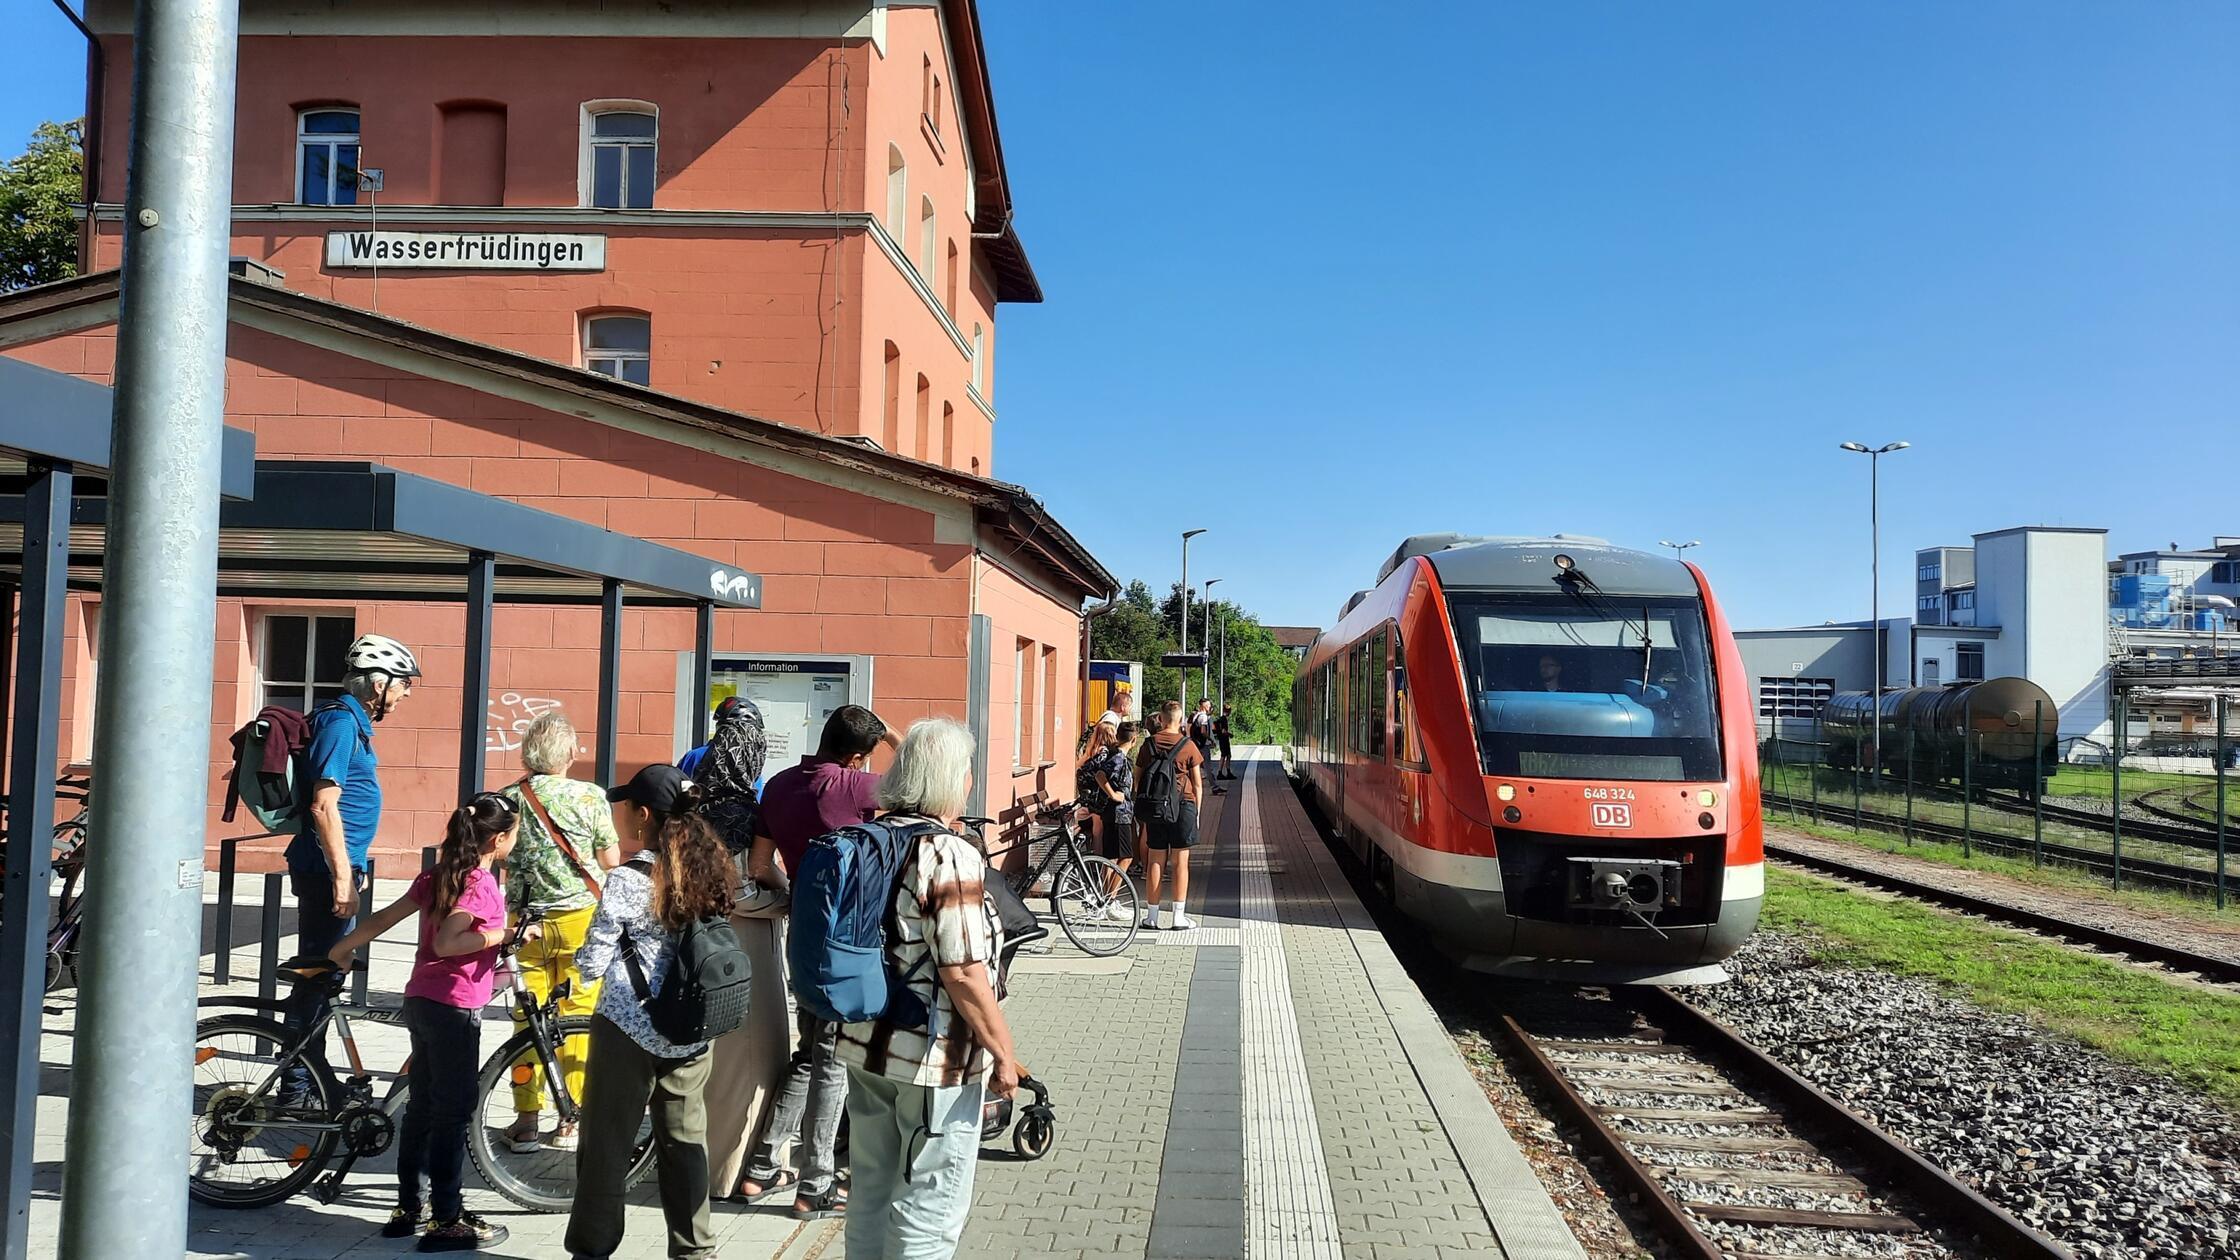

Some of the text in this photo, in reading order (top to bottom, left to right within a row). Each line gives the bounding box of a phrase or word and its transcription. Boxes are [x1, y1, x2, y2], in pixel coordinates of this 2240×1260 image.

[349, 233, 584, 268] Wassertrüdingen
[748, 661, 799, 672] Information
[1584, 787, 1636, 801] 648 324
[1595, 806, 1628, 824] DB
